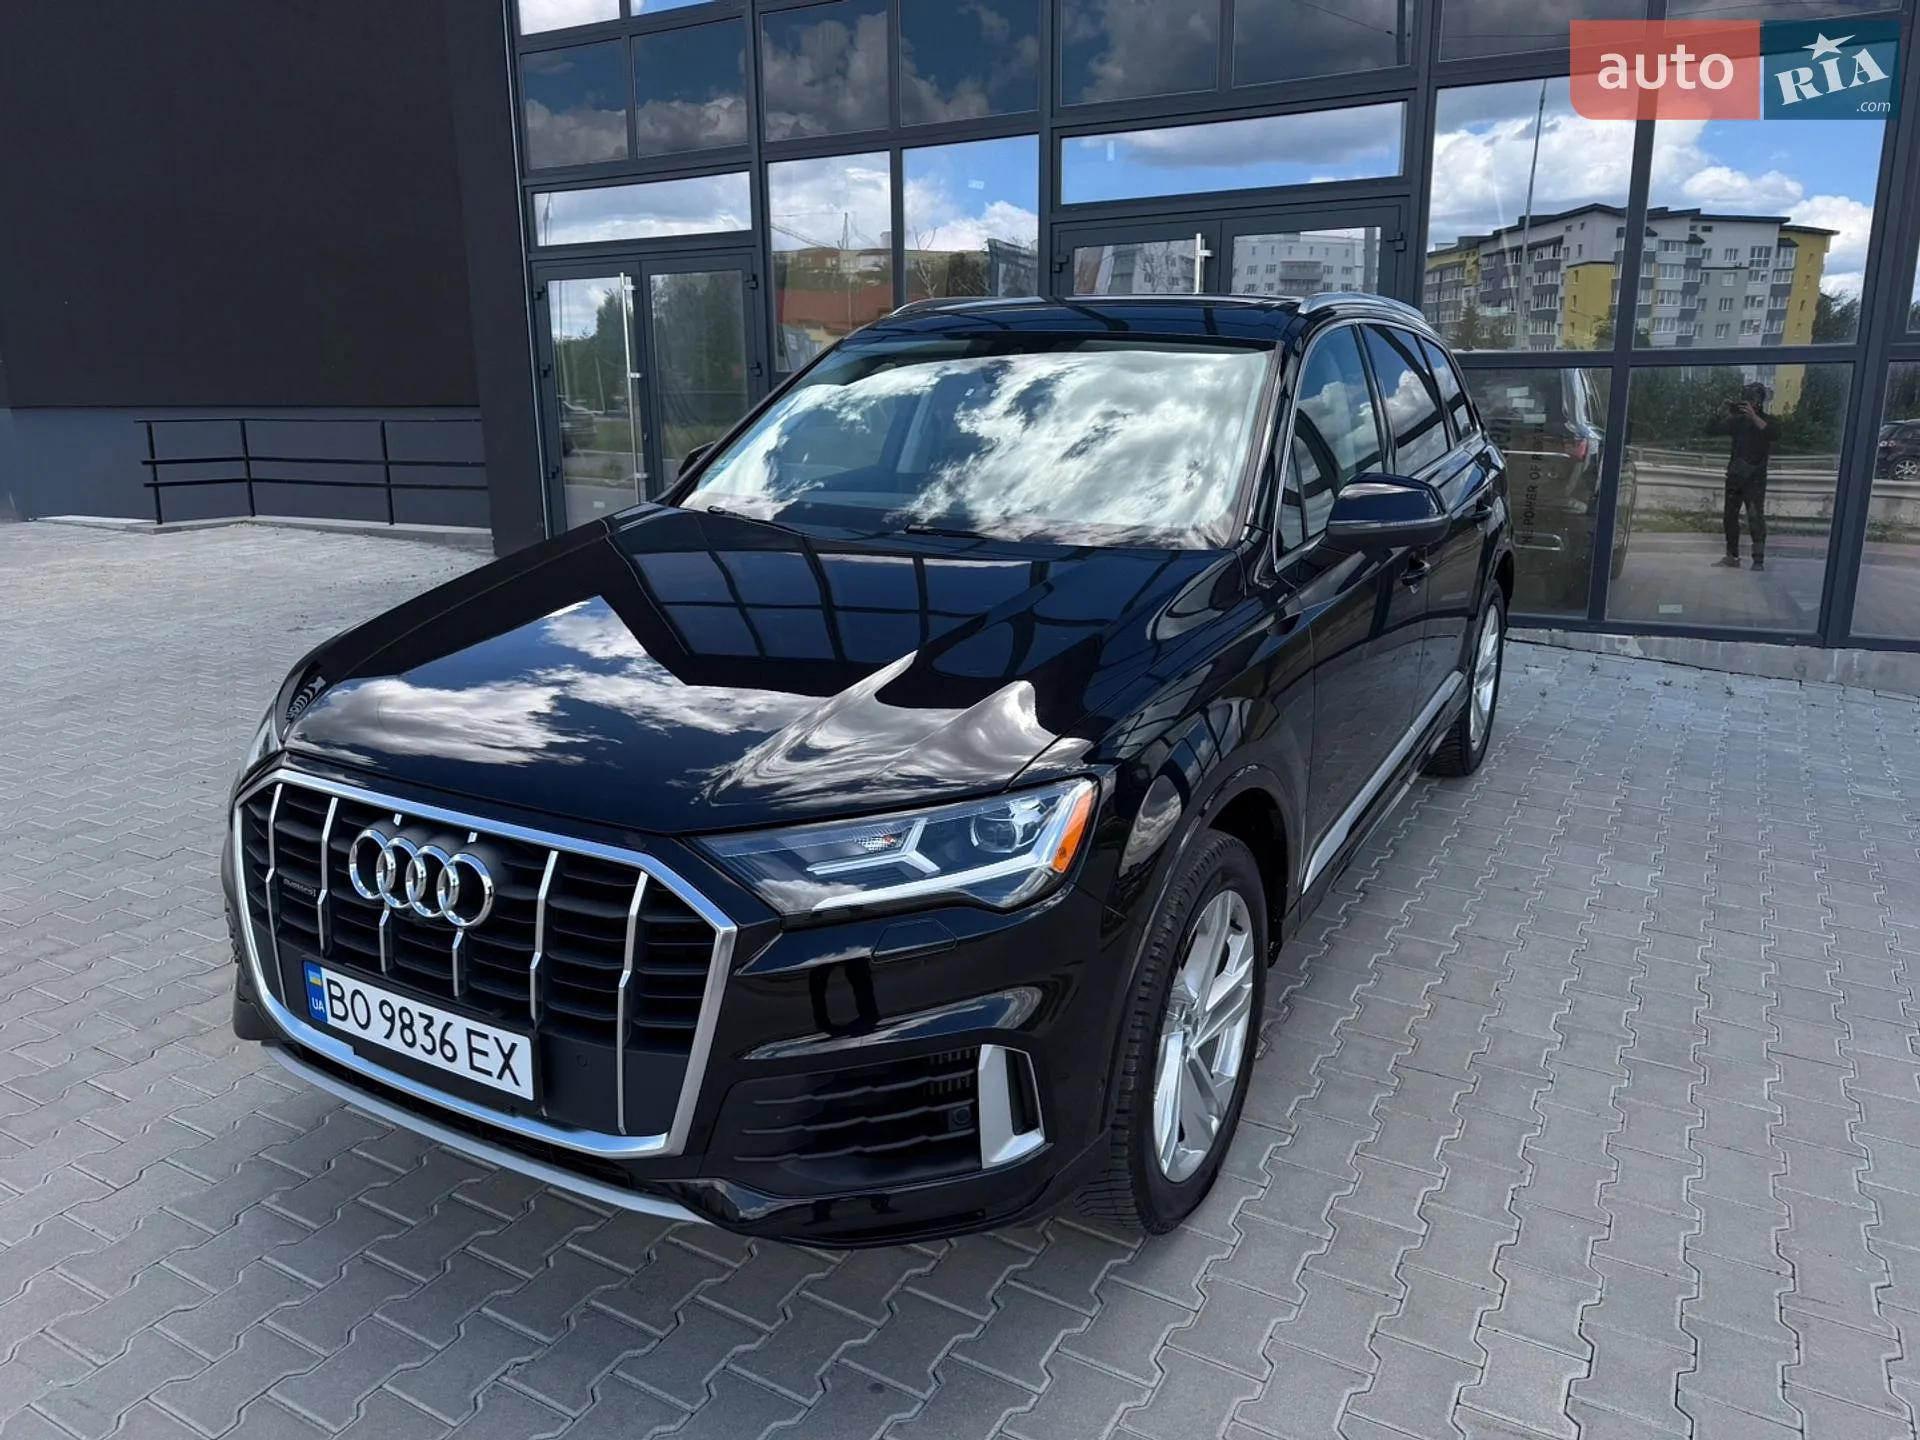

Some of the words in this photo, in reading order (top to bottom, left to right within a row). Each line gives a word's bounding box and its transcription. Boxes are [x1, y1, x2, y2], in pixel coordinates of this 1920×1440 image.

[311, 997, 325, 1014] UA
[326, 978, 371, 1030] BO
[378, 999, 457, 1063] 9836
[466, 1027, 520, 1086] EX
